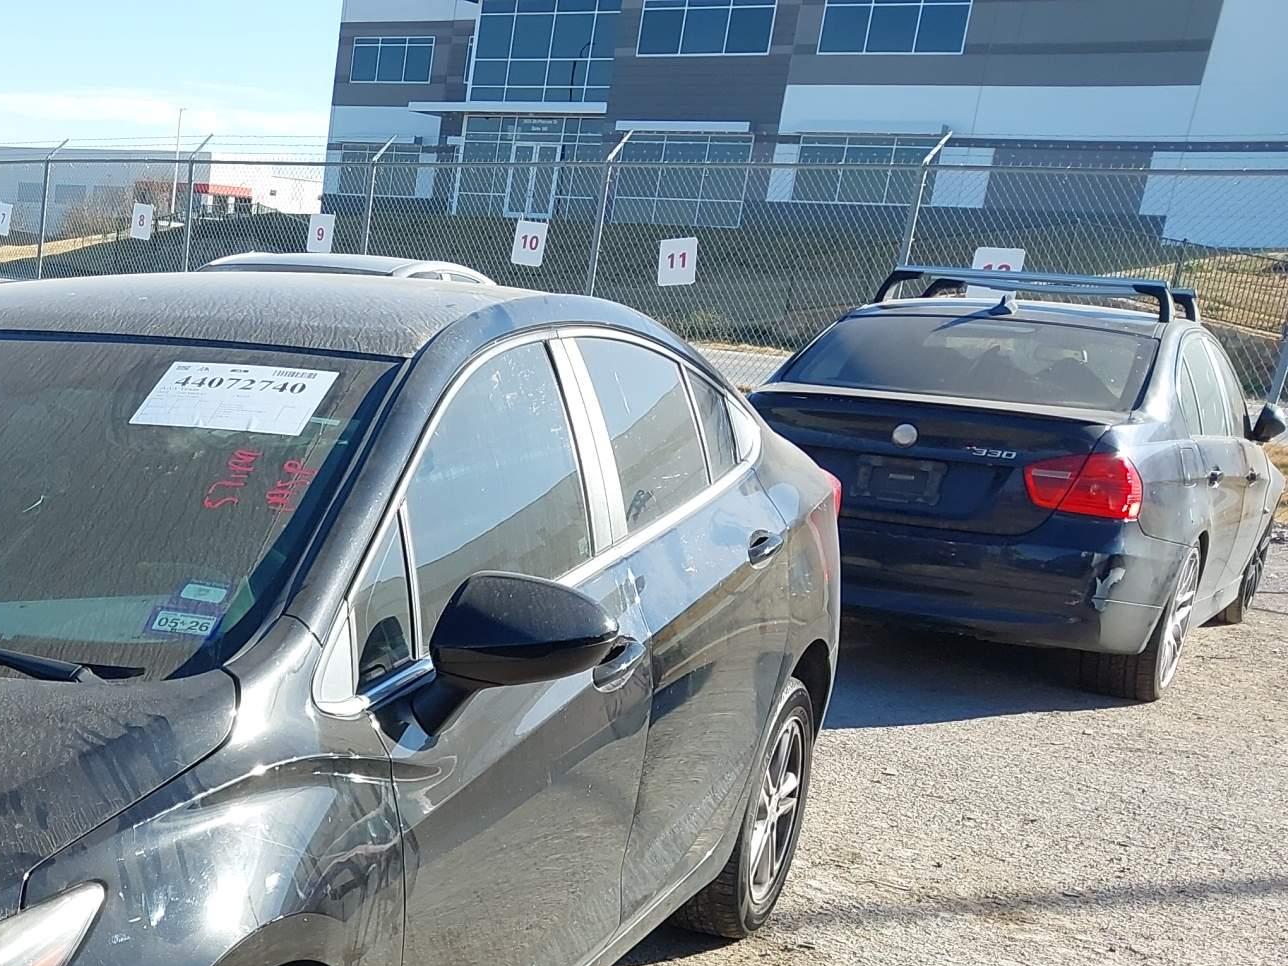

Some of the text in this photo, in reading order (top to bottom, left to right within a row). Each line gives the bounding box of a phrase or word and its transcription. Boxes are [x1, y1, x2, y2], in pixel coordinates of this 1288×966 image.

[0, 213, 6, 225] 7
[138, 214, 145, 227] 8
[317, 227, 325, 241] 9
[521, 235, 539, 251] 10
[667, 252, 688, 269] 11
[174, 375, 307, 394] 44072740
